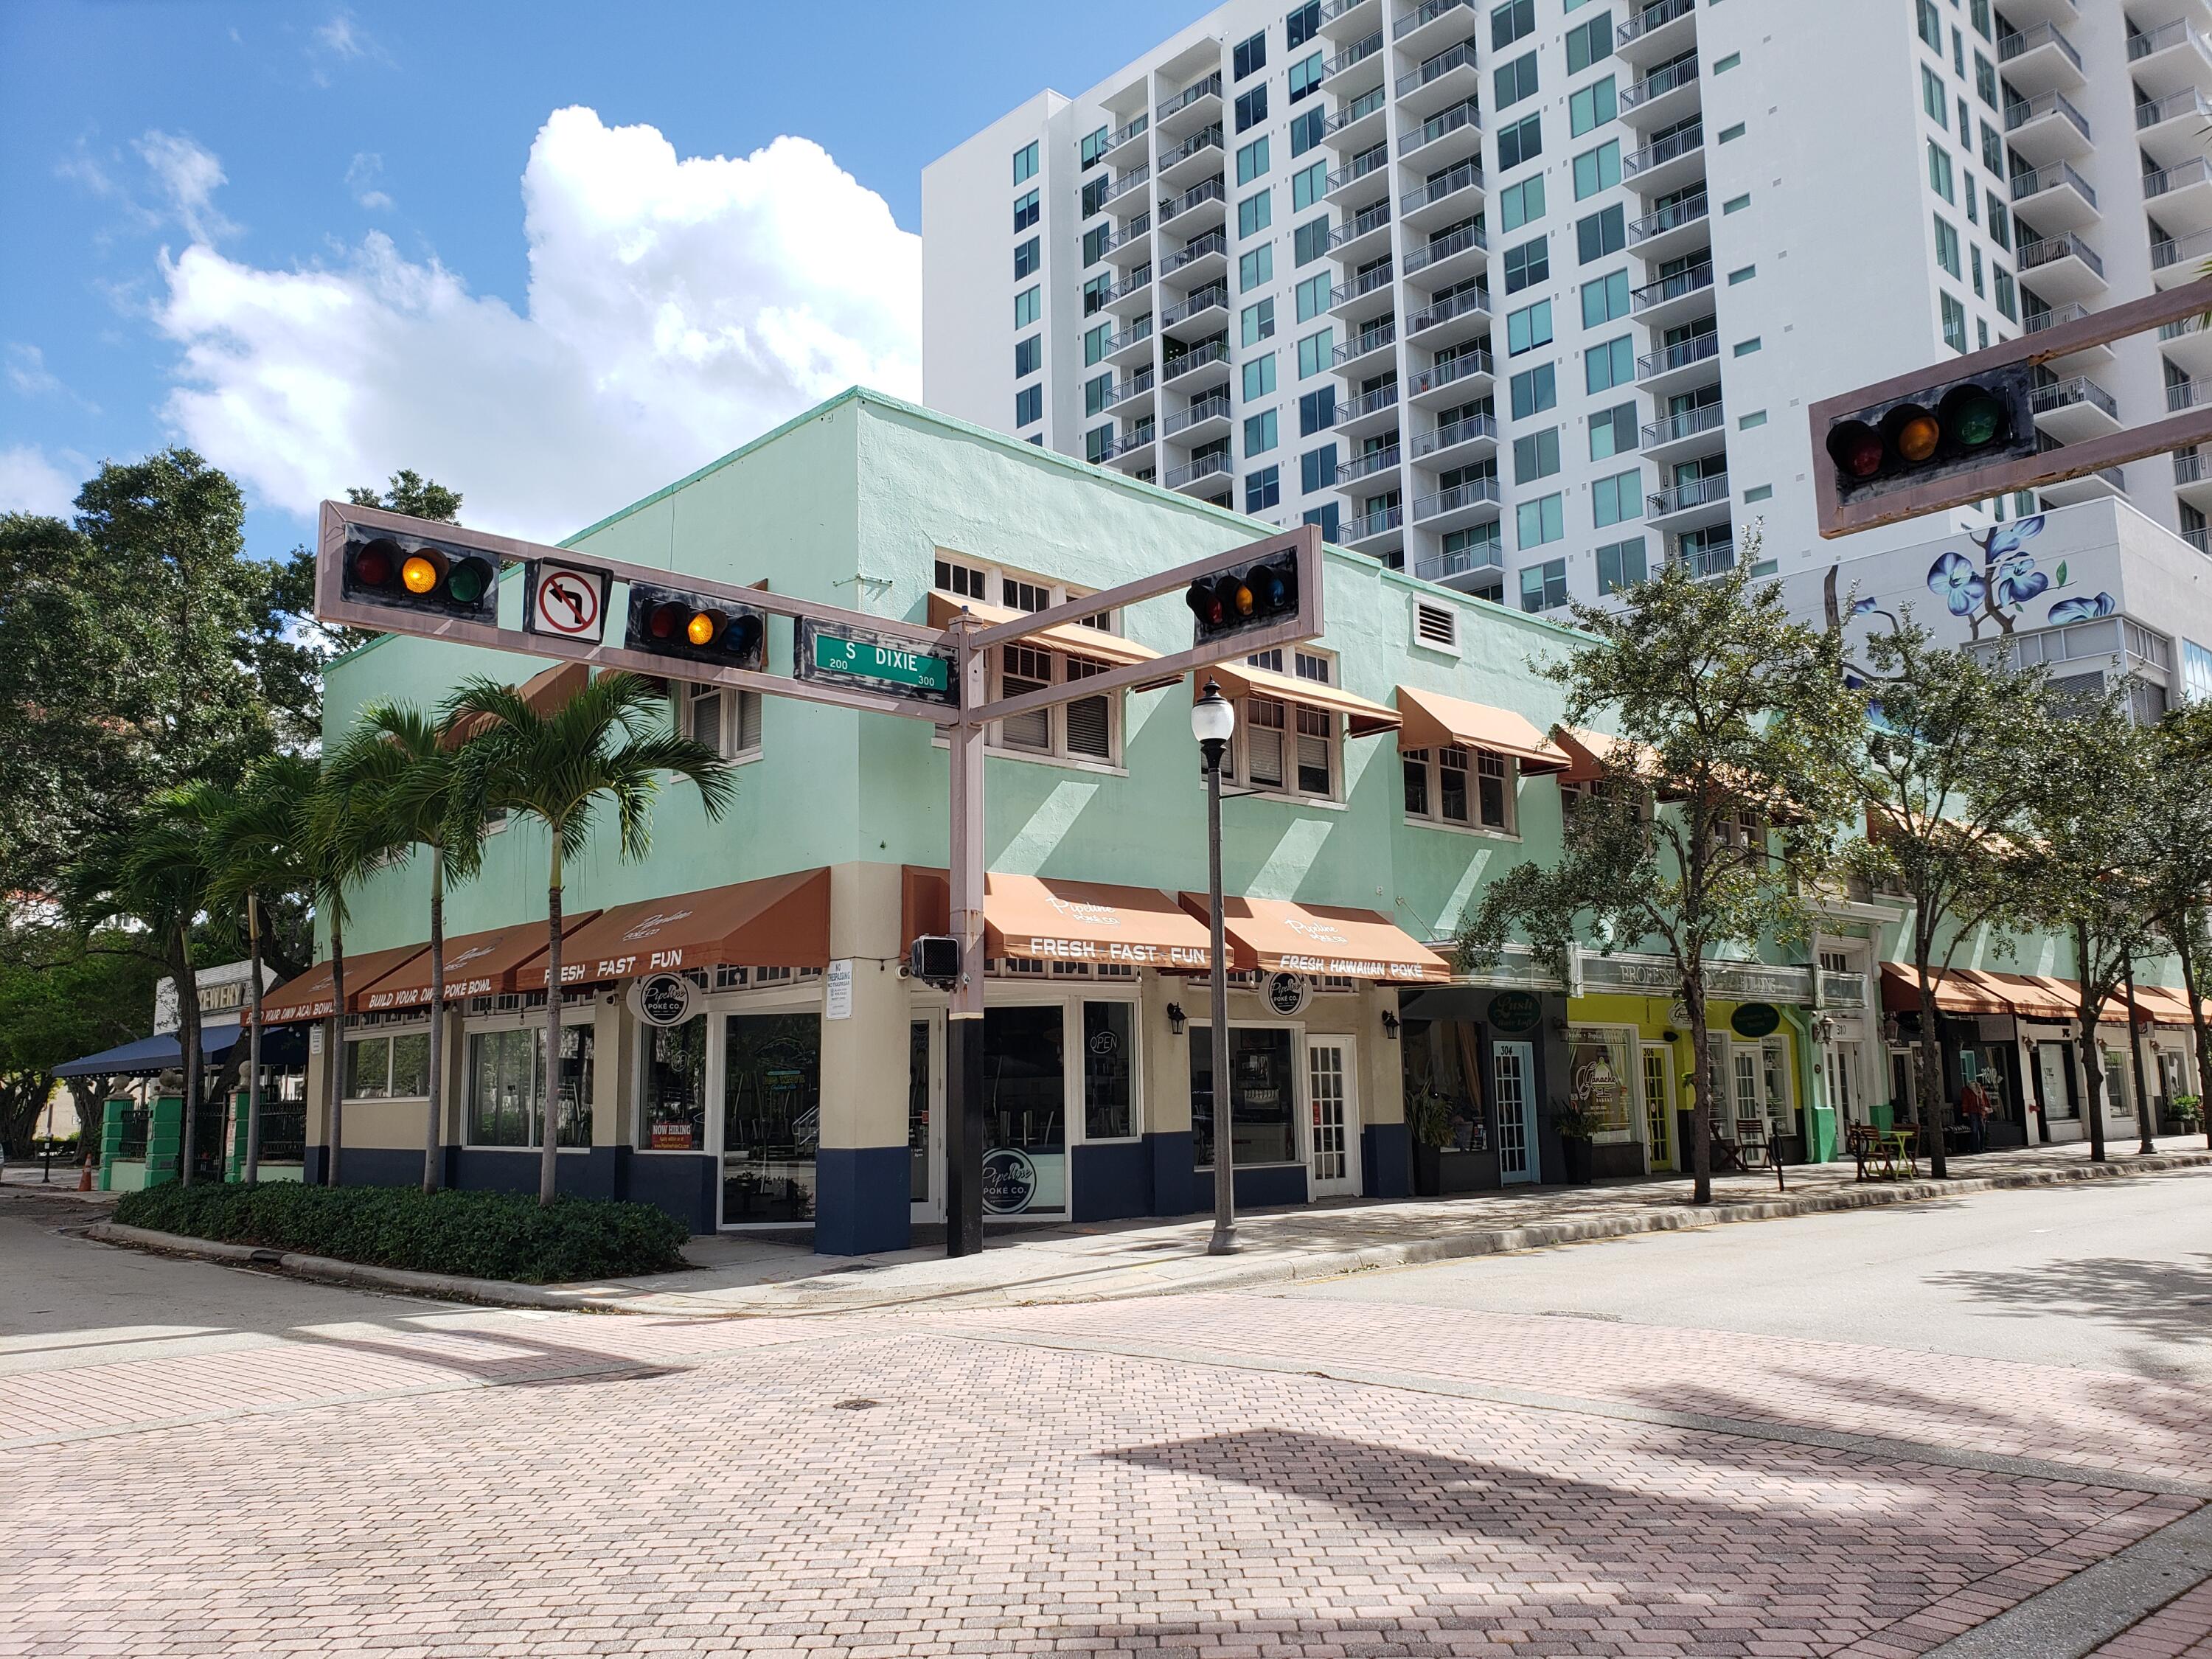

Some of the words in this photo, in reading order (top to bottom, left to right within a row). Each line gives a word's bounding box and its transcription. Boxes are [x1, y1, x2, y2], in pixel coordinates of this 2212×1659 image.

[830, 658, 848, 669] 200
[846, 642, 856, 659] S
[876, 648, 918, 672] DIXIE
[918, 675, 935, 686] 300
[1045, 897, 1116, 916] Pipeline
[1284, 919, 1339, 934] Pipeline
[1031, 938, 1096, 958] FRESH
[1110, 944, 1158, 961] FAST
[1171, 947, 1206, 964] FUN
[544, 964, 585, 984] FESH
[597, 956, 636, 977] FAST
[650, 949, 682, 970] FUN
[835, 963, 841, 972] NO
[1280, 955, 1324, 971] FRESH
[1330, 959, 1385, 975] HAWAIIAN
[1391, 961, 1424, 978] POKÉ
[827, 972, 850, 982] TRESPASSING
[1739, 975, 1776, 993] BUILDING
[369, 992, 394, 1008] BUILD
[395, 990, 418, 1006] YOUR
[420, 987, 434, 1003] OW
[443, 979, 467, 998] POKÉ
[467, 978, 492, 995] BOWL
[644, 984, 686, 1004] Pipeline
[264, 1008, 281, 1023] YOUR
[281, 1006, 296, 1020] OWN
[313, 1001, 335, 1016] BOWL
[1837, 1024, 1846, 1035] 310
[1091, 1035, 1117, 1049] OPEN
[1500, 1046, 1513, 1055] 304
[1644, 1048, 1654, 1057] 306
[1576, 1062, 1616, 1100] Ganache
[653, 1124, 668, 1135] NOW
[668, 1124, 691, 1135] HIRING
[983, 1162, 1033, 1188] Pipeline
[983, 1186, 1009, 1194] POKÉ
[1011, 1186, 1027, 1194] CO.
